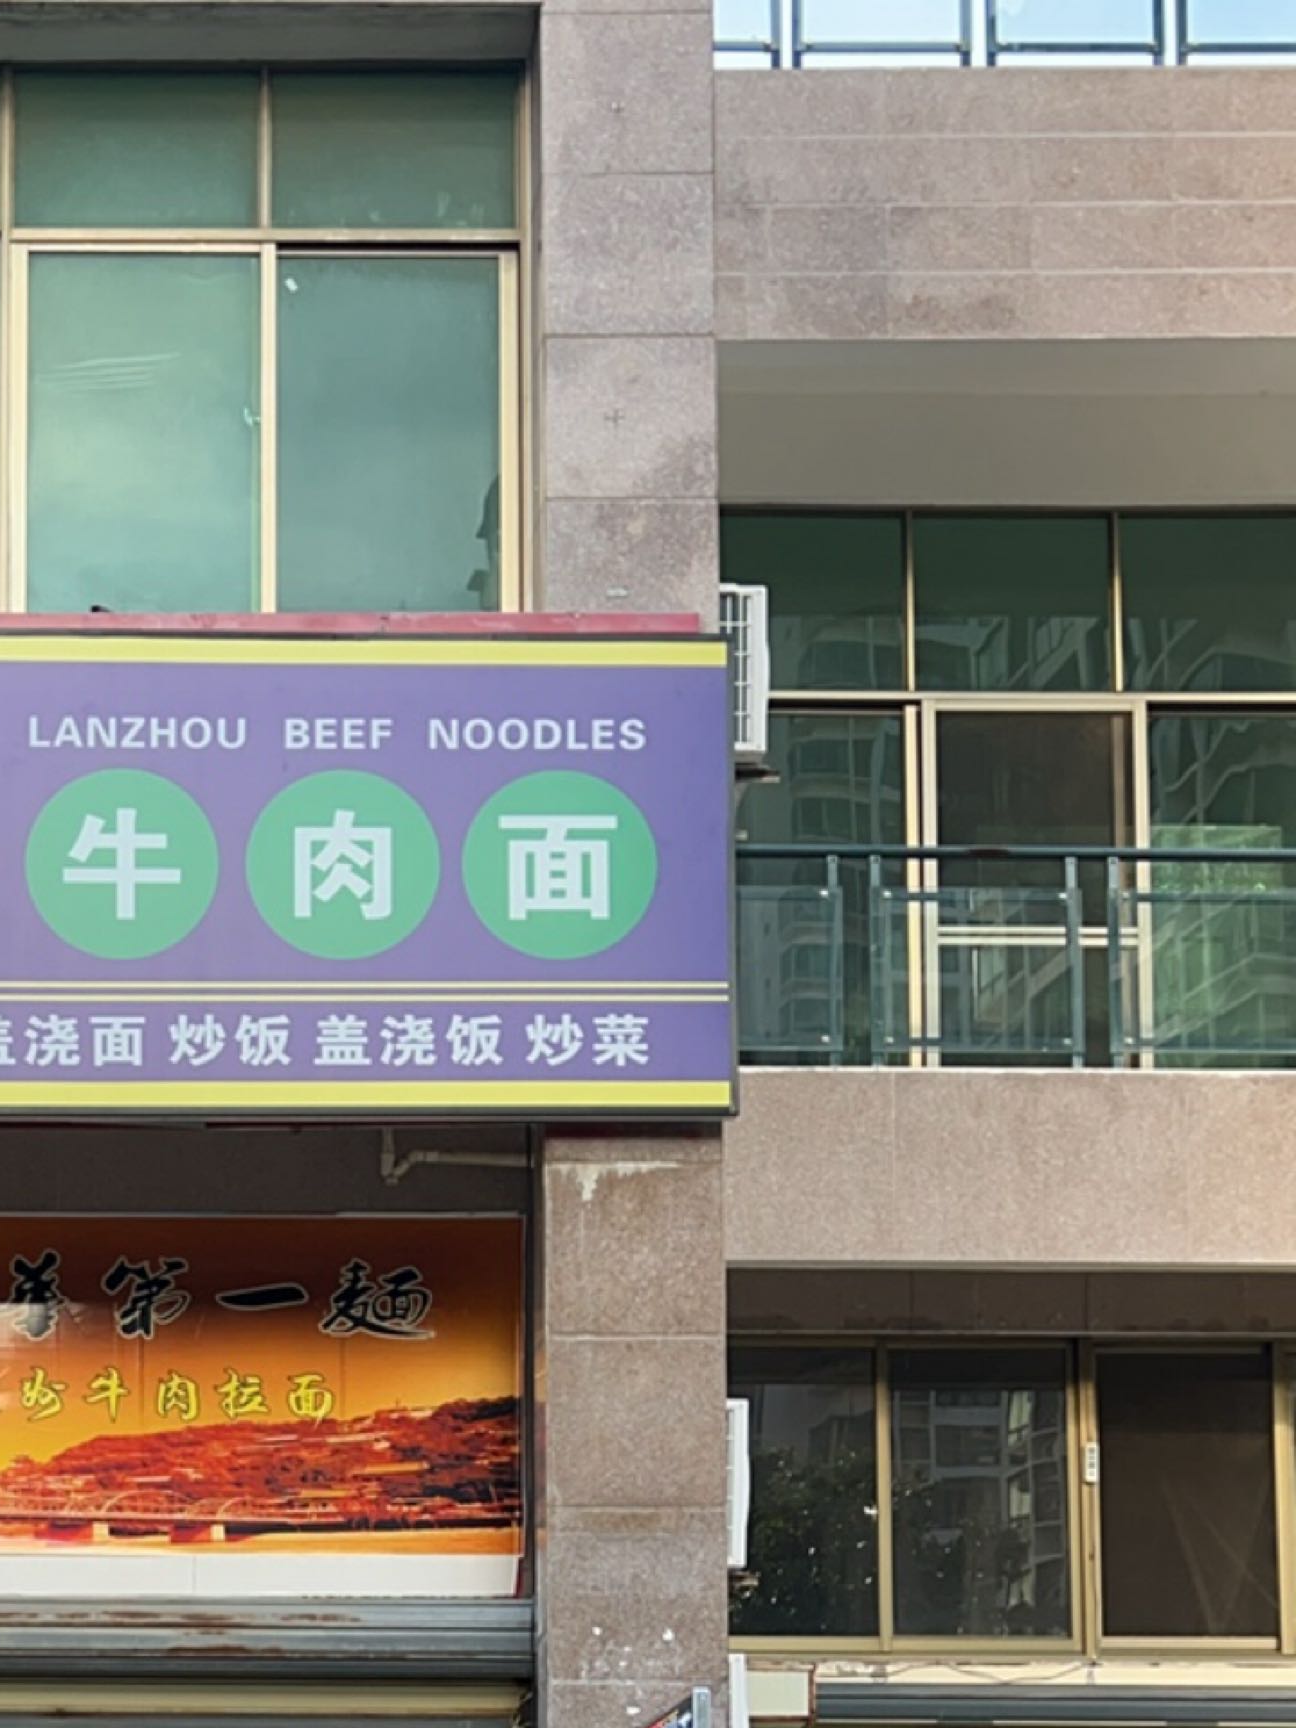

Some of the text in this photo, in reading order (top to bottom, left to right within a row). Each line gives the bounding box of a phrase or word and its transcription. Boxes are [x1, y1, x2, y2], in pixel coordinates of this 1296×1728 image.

[28, 715, 646, 750] LANZHOU BEEF NOODLES
[62, 808, 618, 922] 牛肉面
[170, 1013, 291, 1066] 炒饭
[314, 1014, 502, 1066] 盖浇饭
[526, 1014, 650, 1066] 炒菜
